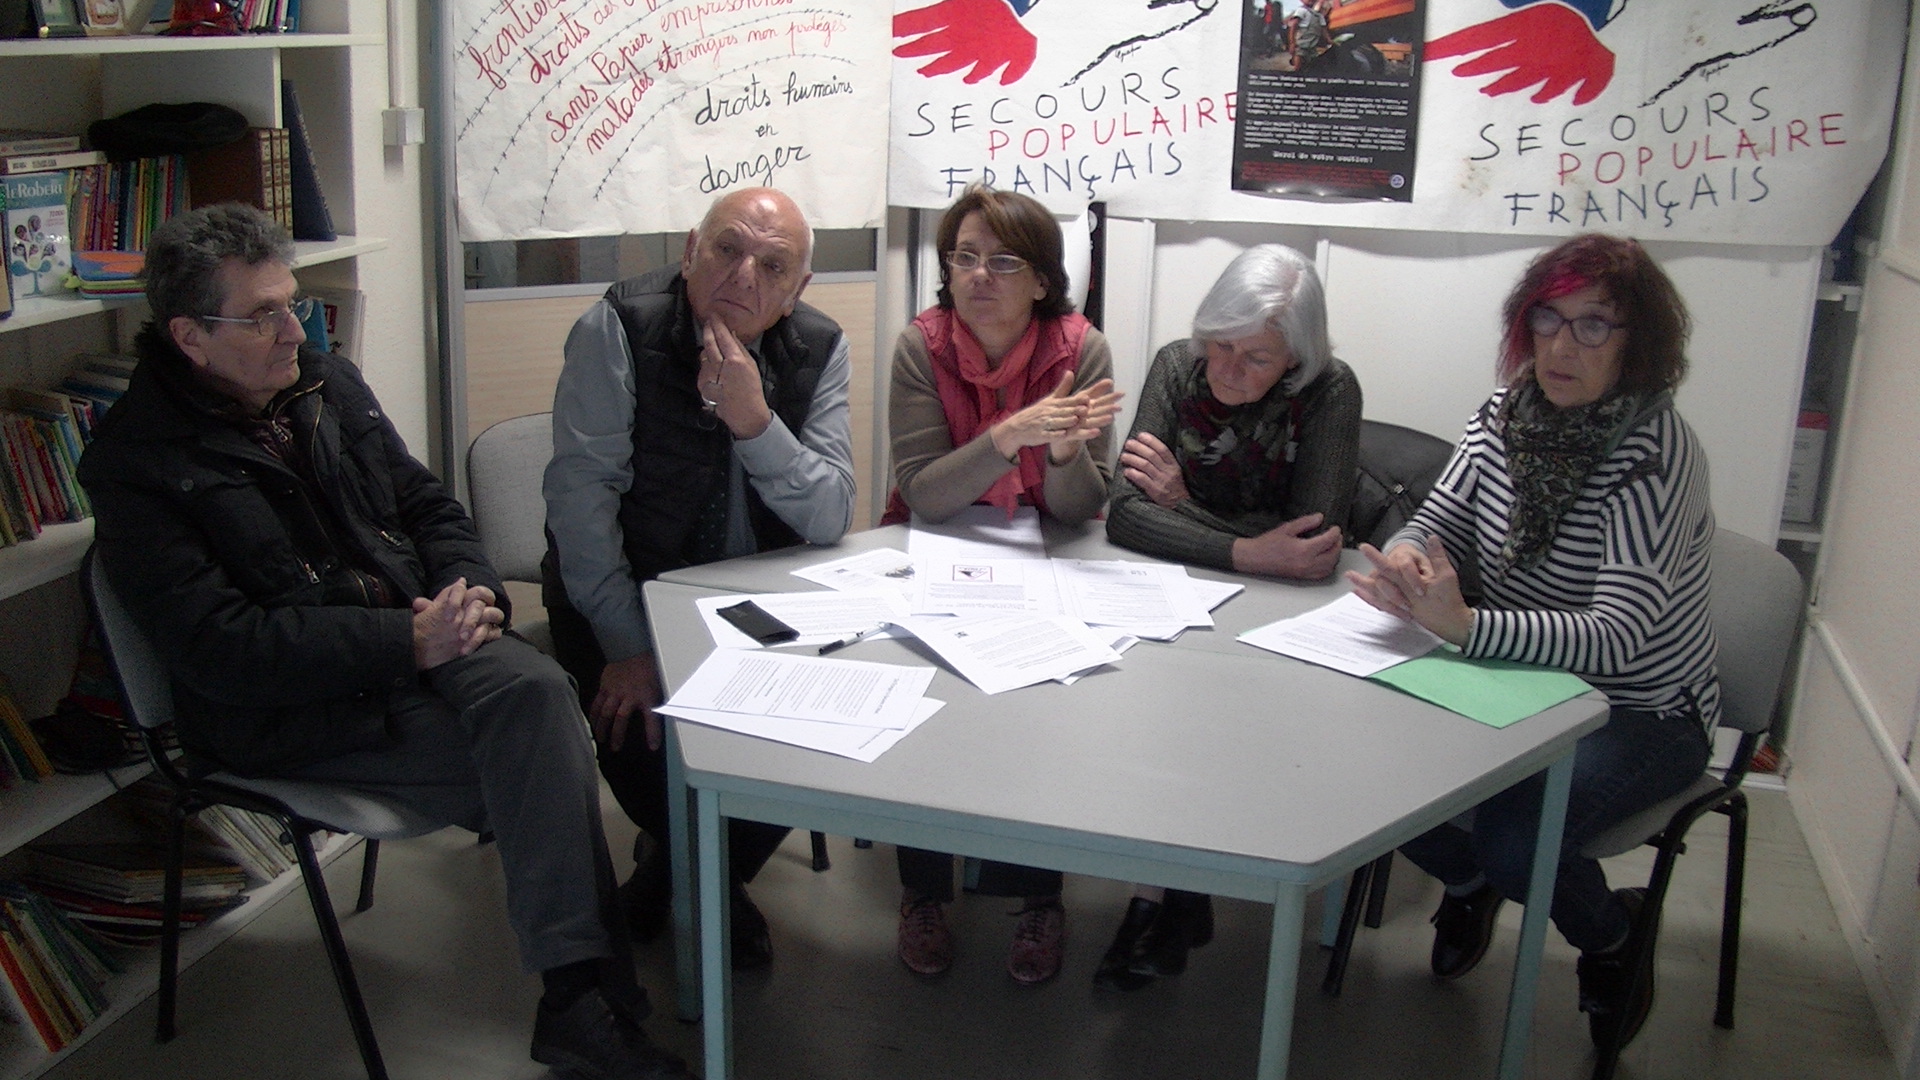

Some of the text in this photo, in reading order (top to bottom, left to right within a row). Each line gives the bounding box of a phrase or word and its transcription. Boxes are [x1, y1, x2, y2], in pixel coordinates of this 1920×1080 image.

[530, 12, 590, 84] droits
[545, 84, 599, 143] Sans
[591, 31, 653, 85] Papier
[586, 71, 654, 155] malades
[748, 28, 779, 42] non
[695, 71, 854, 126] droits humains
[908, 66, 1181, 137] SECOURS
[755, 123, 779, 137] en
[988, 91, 1238, 160] POPULAIRE
[1471, 86, 1772, 160] SECOURS
[1556, 113, 1847, 186] POPULAIRE
[699, 146, 811, 193] danger
[940, 142, 1183, 200] FRANÇAIS
[1503, 166, 1770, 228] FRANÇAIS
